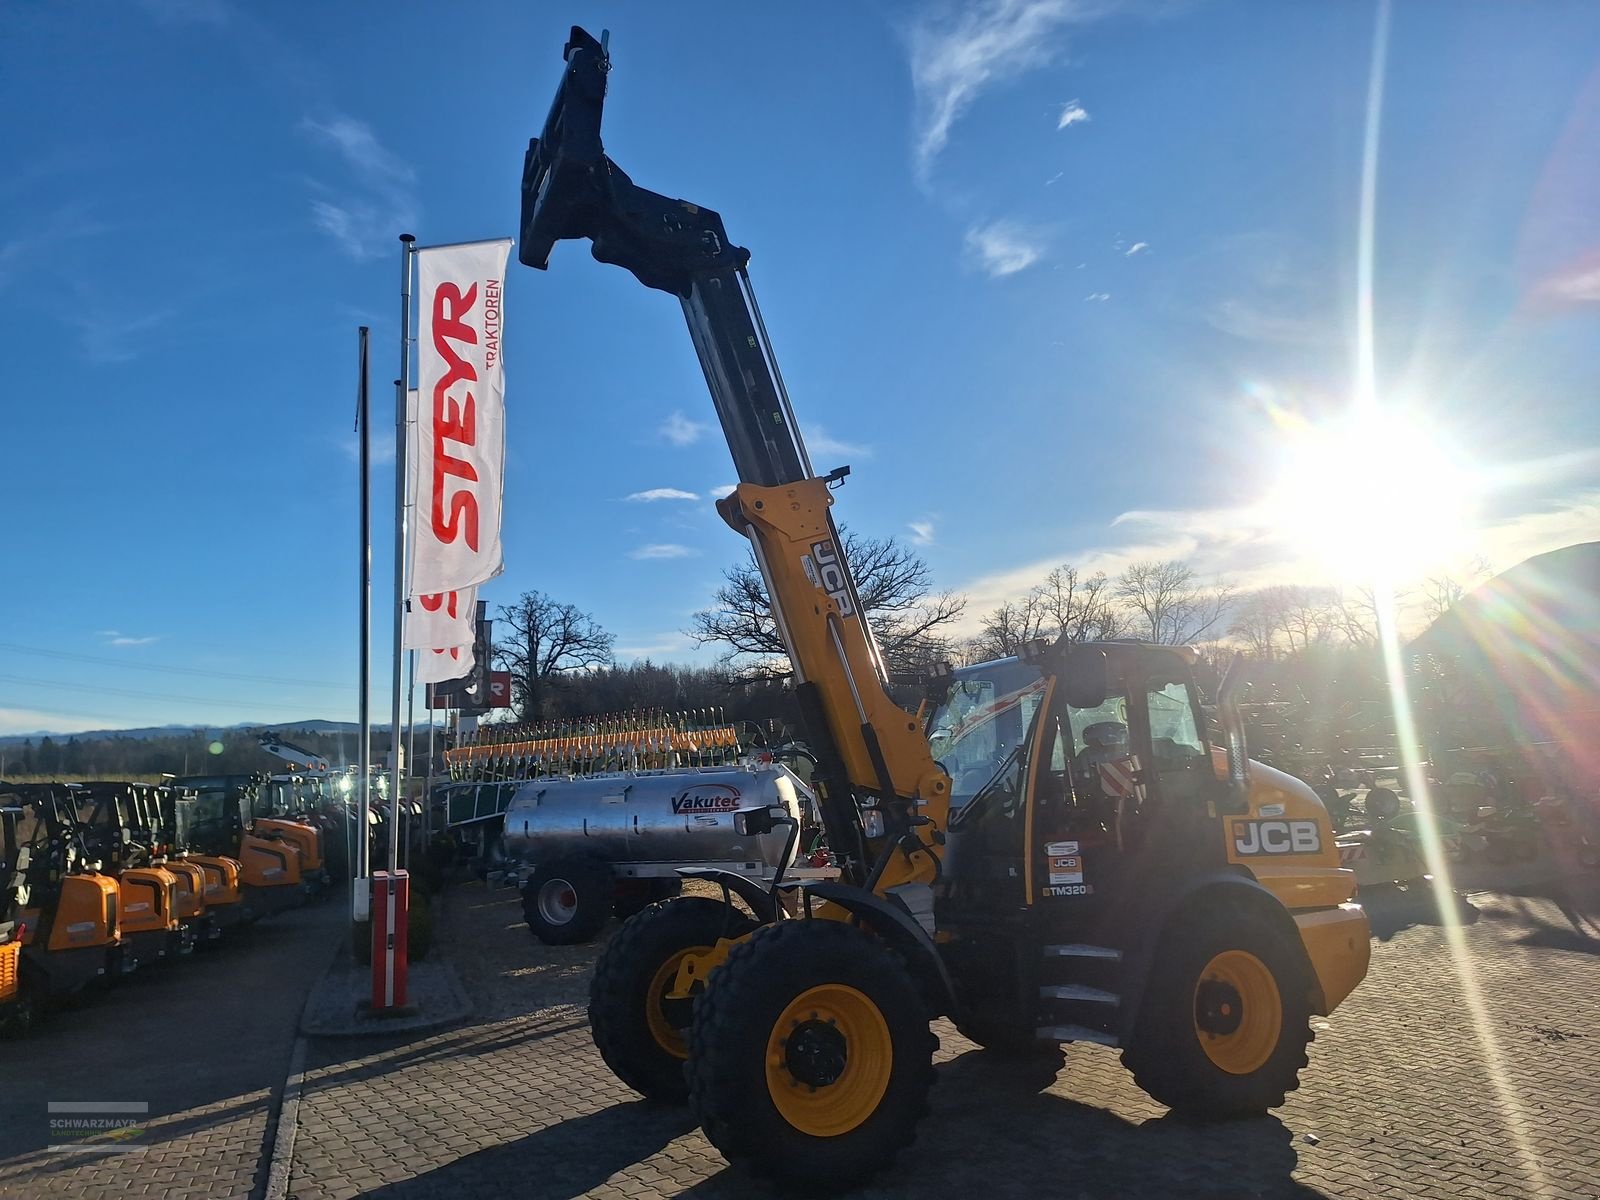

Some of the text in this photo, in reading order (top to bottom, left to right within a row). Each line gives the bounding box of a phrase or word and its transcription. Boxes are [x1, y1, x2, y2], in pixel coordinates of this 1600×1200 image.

[485, 279, 499, 371] TRAKTOREN
[432, 281, 478, 552] STEYR
[671, 792, 740, 814] Vakutec
[1236, 821, 1320, 854] JCB
[1054, 858, 1076, 868] JCB
[1049, 885, 1087, 896] TM320
